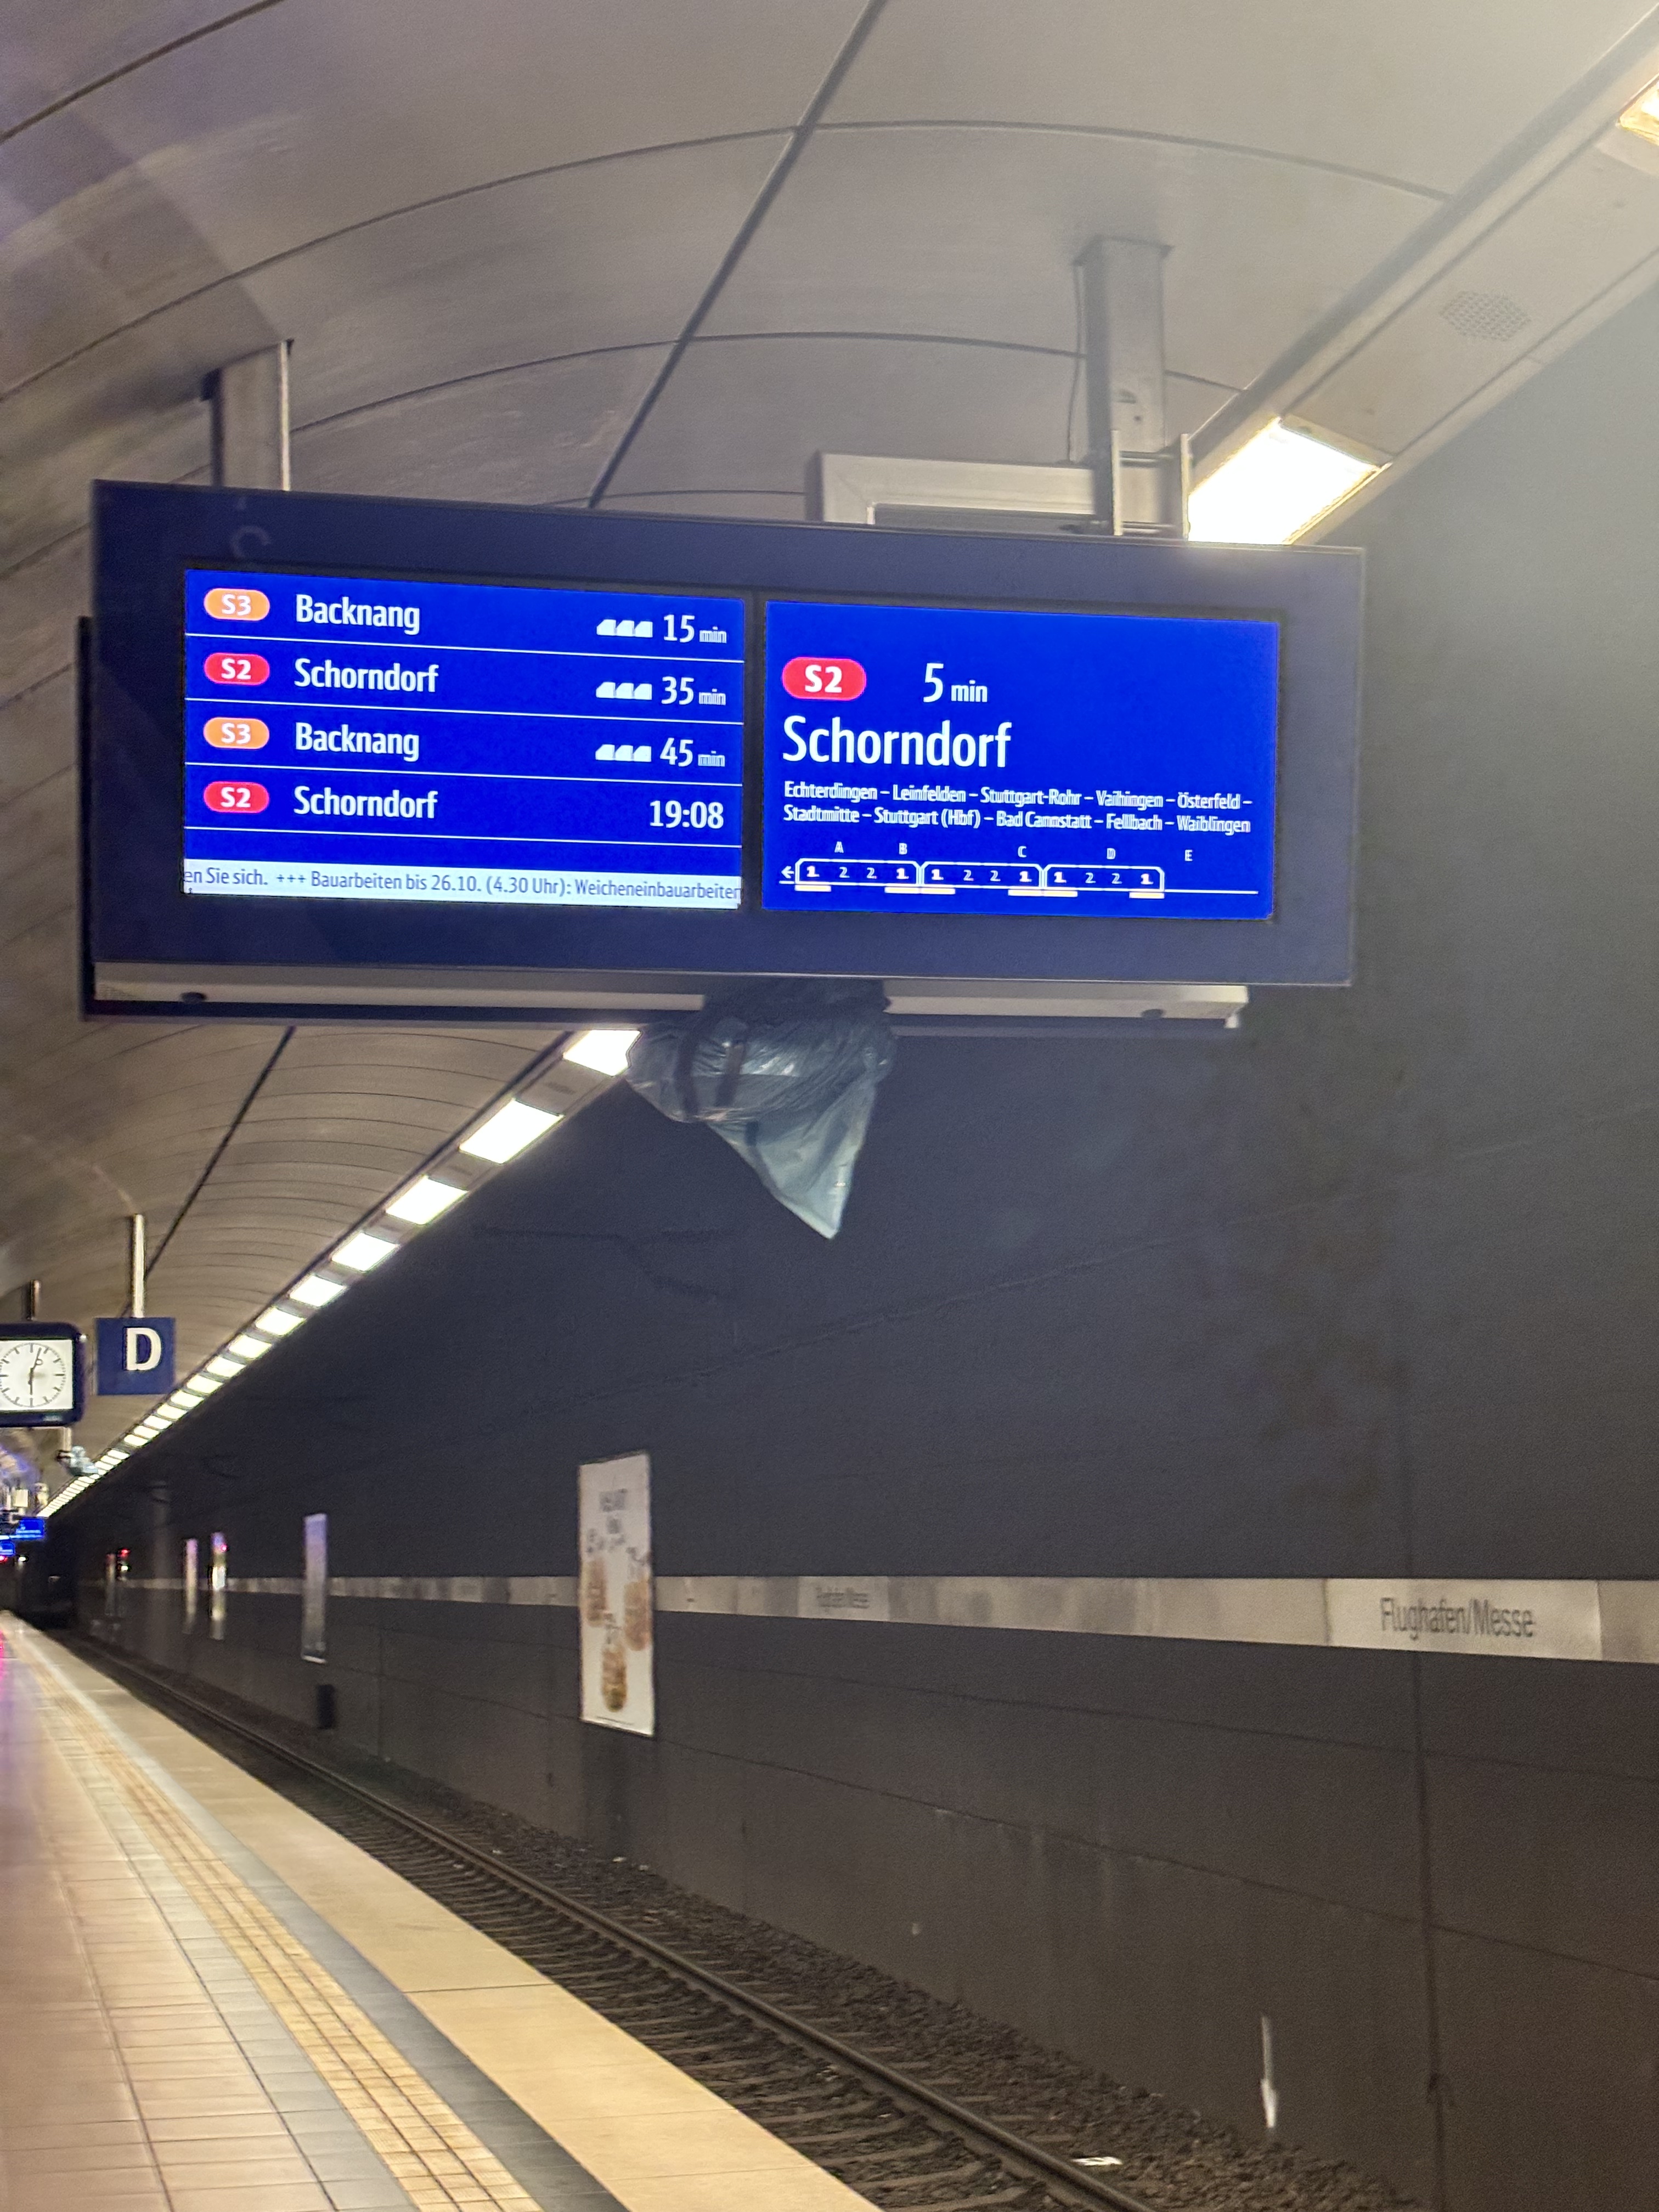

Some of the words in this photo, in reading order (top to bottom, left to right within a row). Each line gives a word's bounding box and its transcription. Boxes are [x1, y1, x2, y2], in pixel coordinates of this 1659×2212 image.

[221, 594, 252, 616] S3
[296, 594, 420, 635] Backnang
[663, 614, 695, 643] 15
[699, 626, 727, 644] min
[221, 658, 251, 680] S2
[294, 658, 439, 692] Schorndorf
[661, 676, 695, 705] 35
[698, 688, 726, 706] min
[805, 664, 842, 693] S2
[923, 662, 944, 703] 5
[951, 680, 988, 703] min
[221, 724, 251, 744] S3
[296, 722, 419, 762] Backnang
[659, 737, 693, 767] 45
[697, 750, 725, 767] min
[782, 715, 1012, 768] Schorndorf
[221, 787, 251, 808] S2
[294, 786, 438, 819] Schorndorf
[650, 800, 724, 829] 19:08
[784, 781, 878, 803] Echterdingen
[893, 784, 966, 803] Leinfelden
[980, 786, 1081, 808] Stuttgart-Rohr
[1095, 789, 1164, 811] Vaihingen
[1177, 792, 1241, 810] Österfeld
[783, 804, 860, 823] Stadtmitte
[873, 806, 939, 828] Stuttgart
[940, 808, 981, 829] (Hbf)
[996, 810, 1023, 827] Bad
[1025, 811, 1092, 829] Cannstatt
[1106, 813, 1163, 831] Fellbach
[1176, 815, 1251, 836] Waiblingen
[834, 841, 844, 854] A
[899, 843, 908, 855] B
[1017, 845, 1027, 858] C
[1106, 848, 1116, 860] D
[1184, 849, 1193, 862] E
[205, 867, 230, 884] Sie
[232, 868, 268, 885] sich.
[311, 871, 402, 889] Bauarbeiten
[405, 873, 427, 890] bis
[431, 874, 482, 892] 26.10.
[486, 876, 528, 895] (4.30
[532, 878, 571, 897] Uhr):
[806, 865, 820, 878] 1
[839, 866, 850, 878] 2
[866, 867, 877, 879] 2
[896, 867, 909, 879] 1
[931, 868, 944, 881] 1
[963, 869, 974, 881] 2
[990, 870, 1001, 882] 2
[1019, 871, 1032, 883] 1
[1054, 871, 1067, 883] 1
[1085, 872, 1096, 884] 2
[1111, 873, 1122, 884] 2
[1141, 873, 1154, 885] 1
[126, 1327, 162, 1371] D
[1381, 1597, 1536, 1640] Flughafen/Messe
